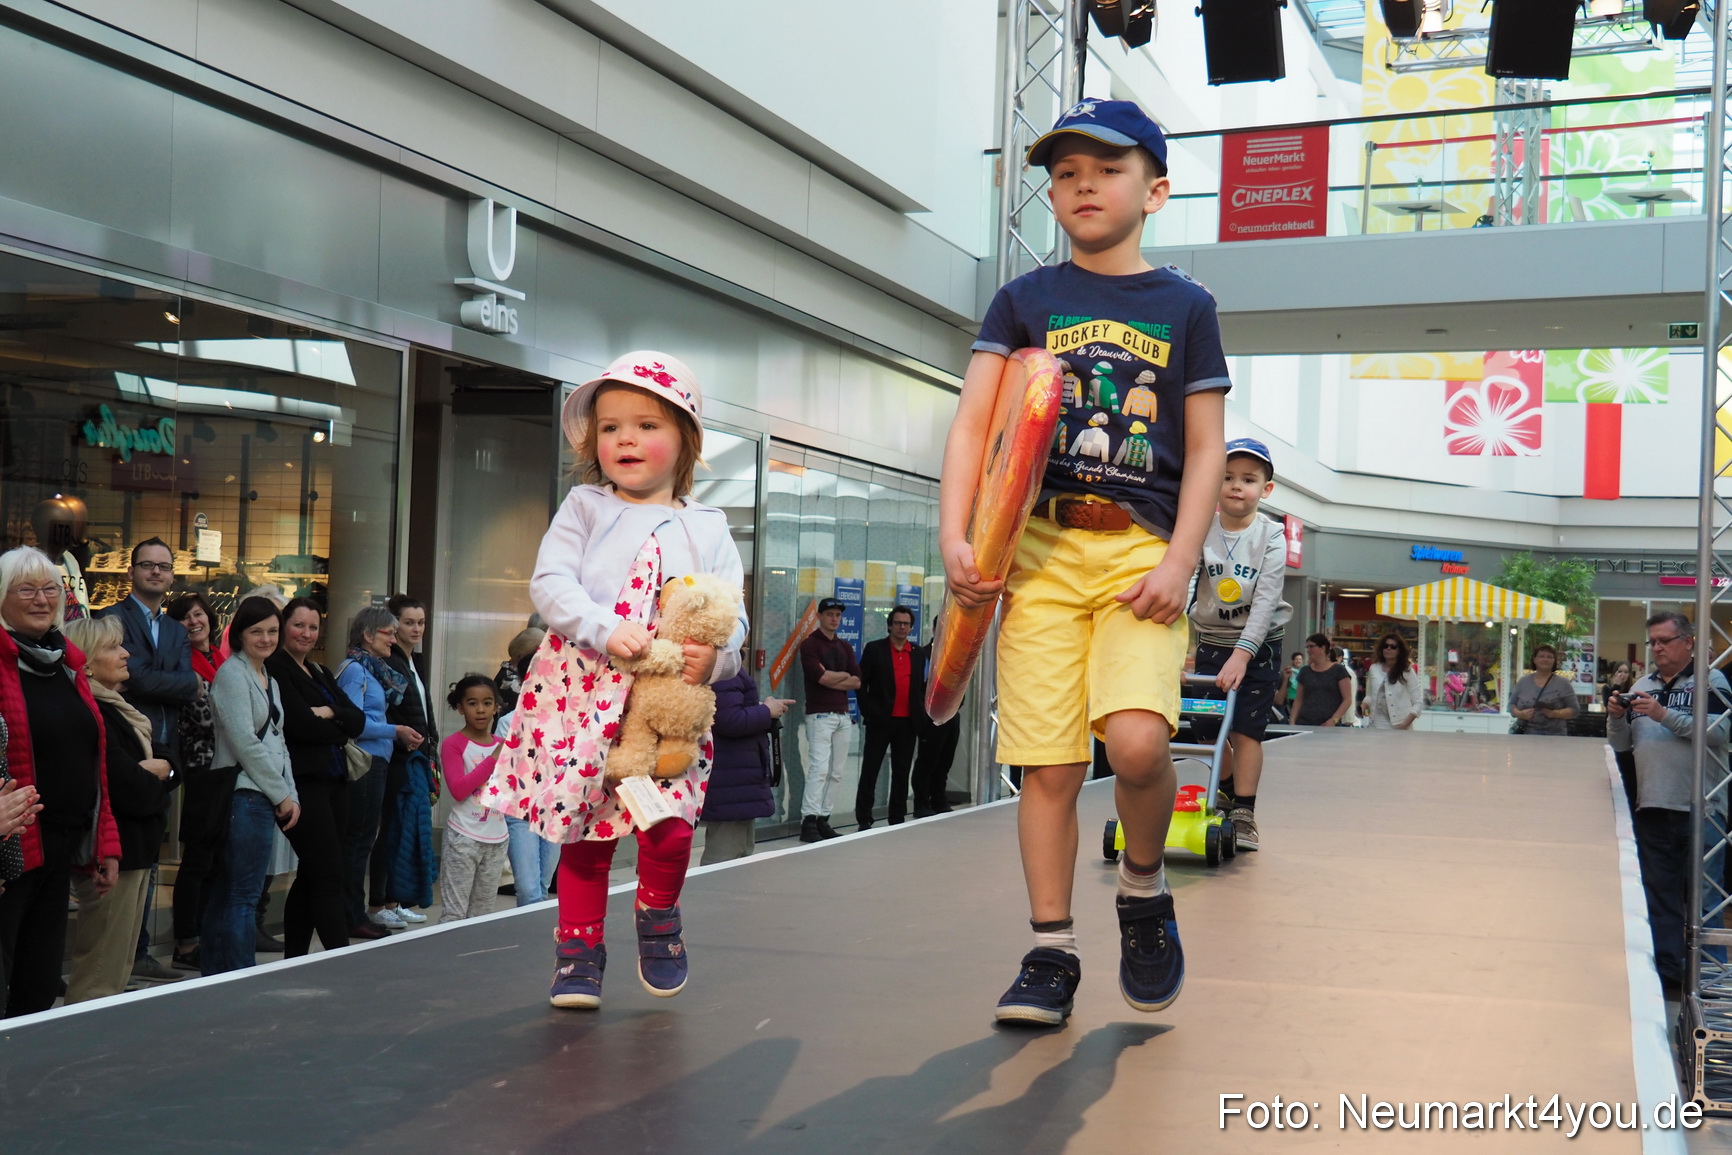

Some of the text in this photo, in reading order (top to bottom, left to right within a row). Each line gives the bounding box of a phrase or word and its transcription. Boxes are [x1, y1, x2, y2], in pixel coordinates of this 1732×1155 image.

[1242, 152, 1305, 166] NeuerMarkt
[1231, 185, 1314, 208] CINEPLEX
[476, 197, 517, 281] U
[1051, 323, 1160, 359] JOCKEY CLUB
[1076, 345, 1087, 356] de
[1410, 544, 1463, 562] Spielwaren
[1234, 563, 1258, 580] SET
